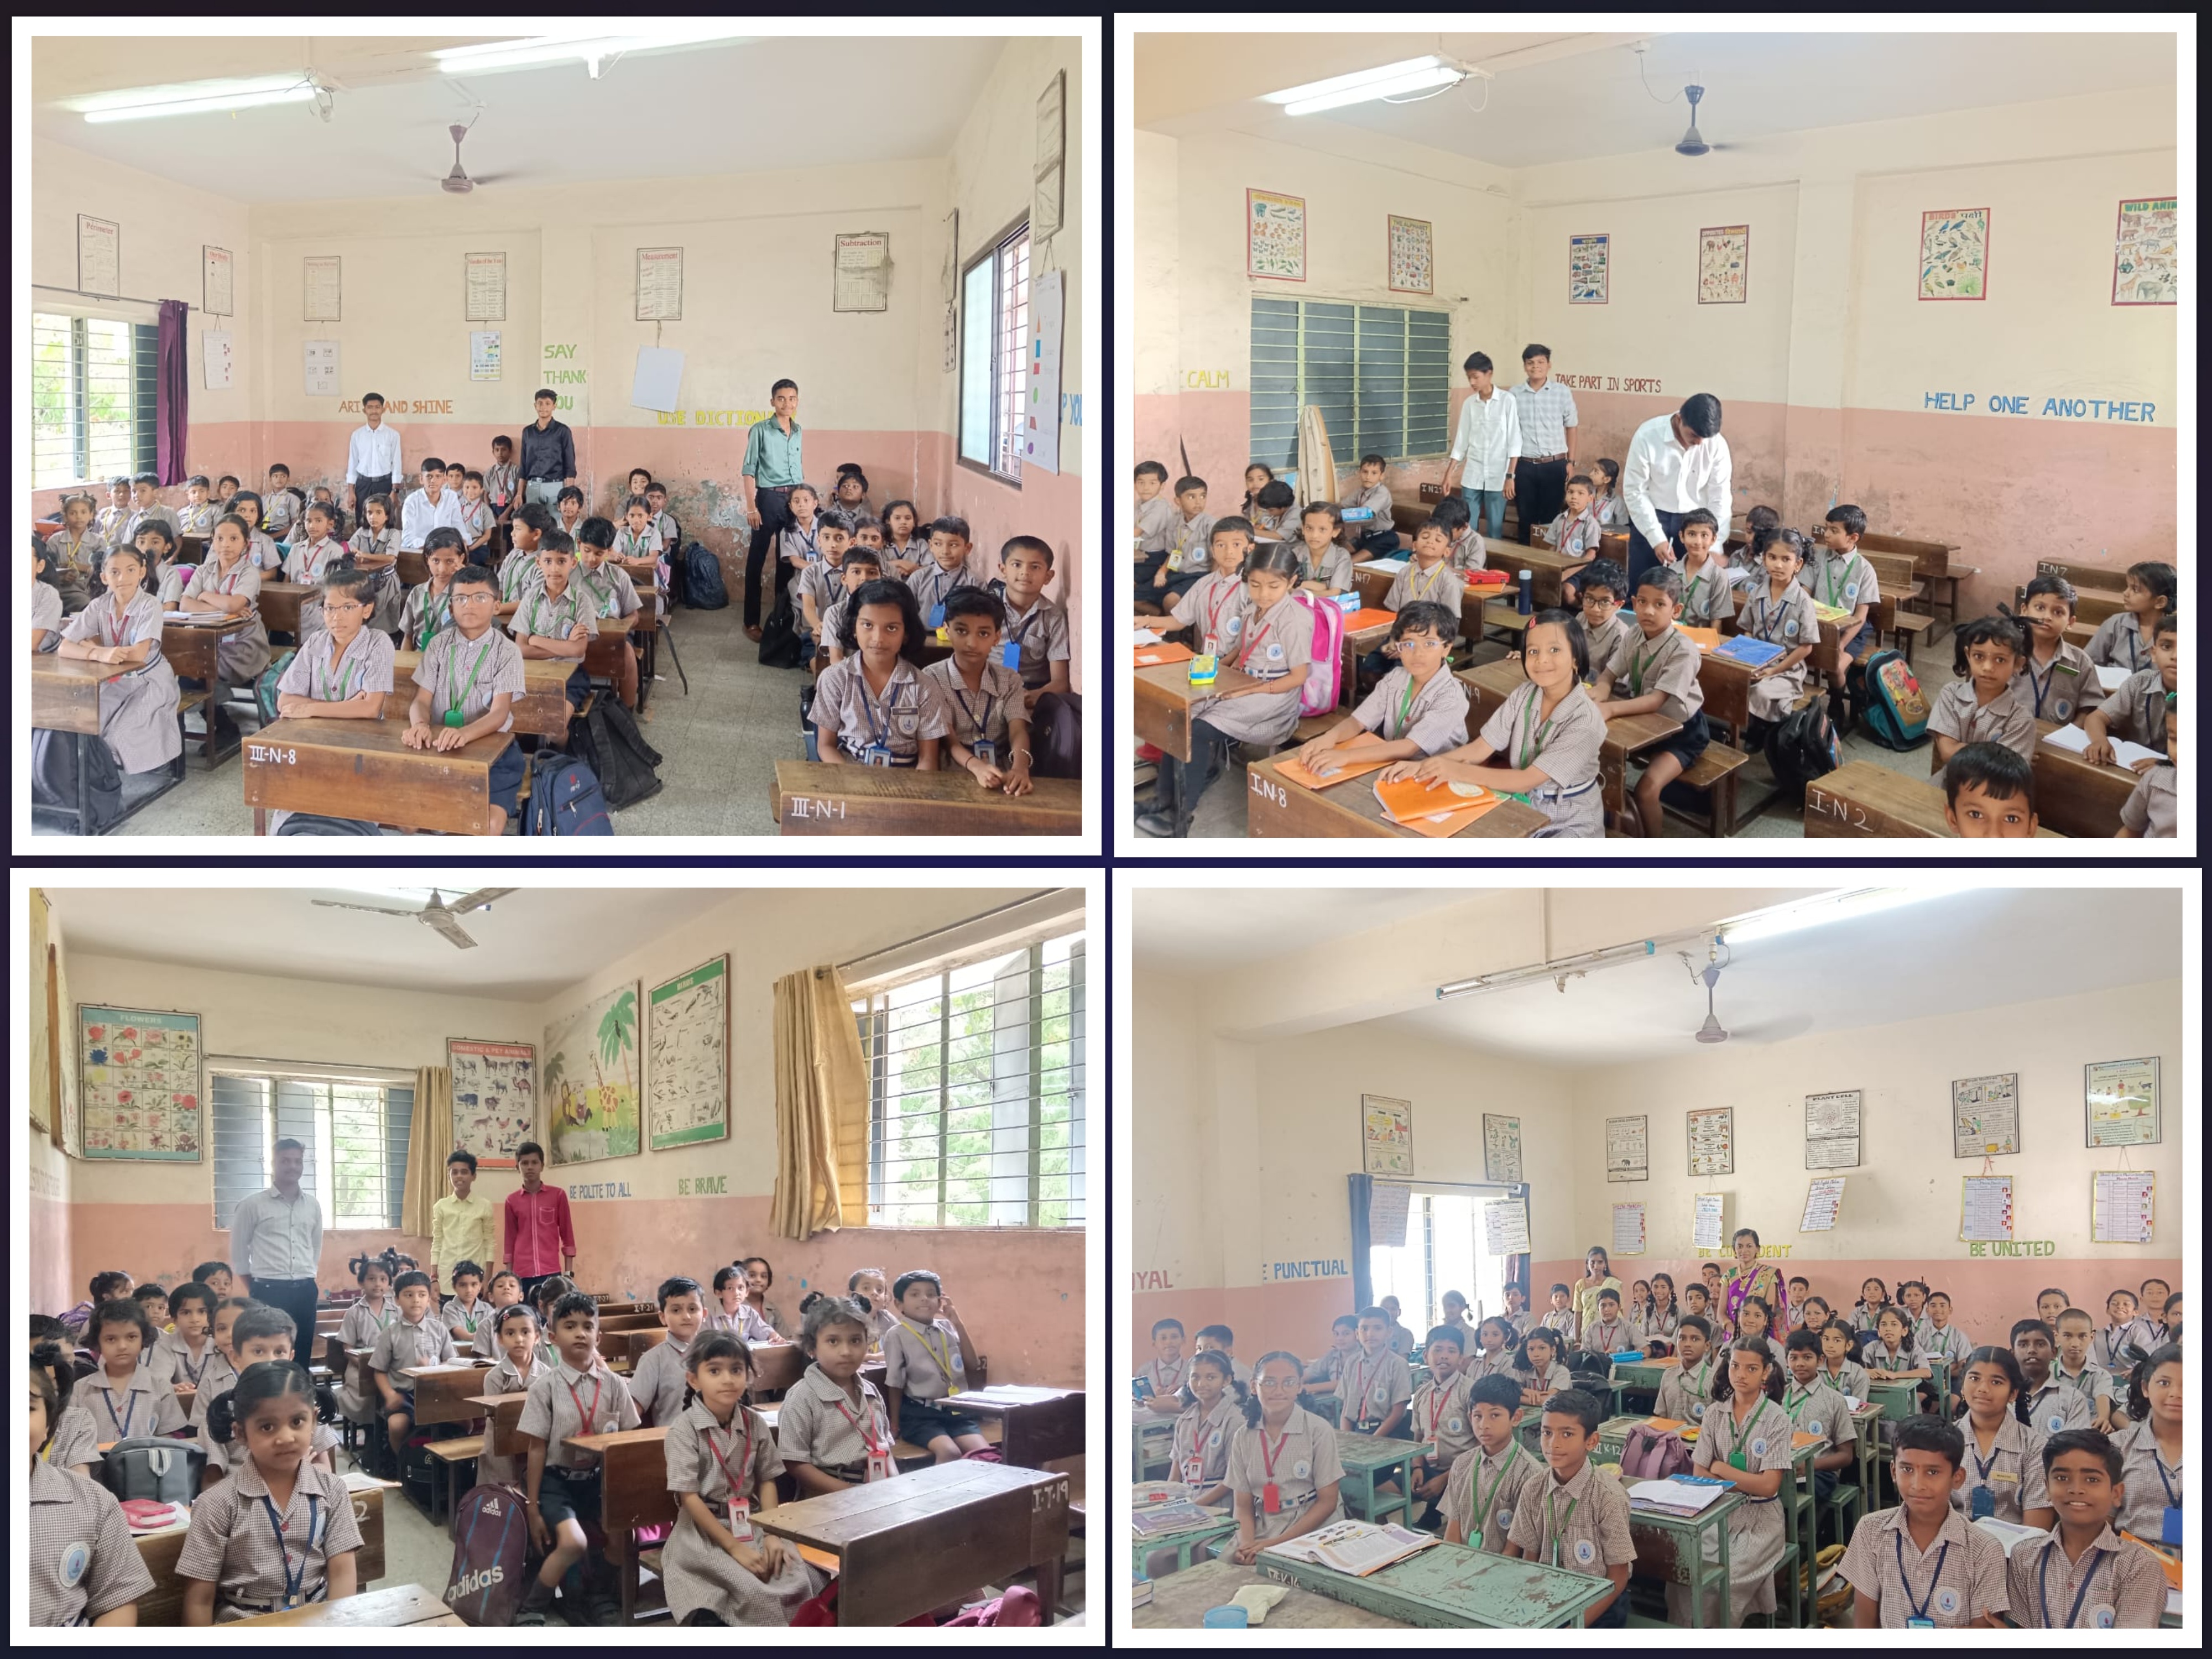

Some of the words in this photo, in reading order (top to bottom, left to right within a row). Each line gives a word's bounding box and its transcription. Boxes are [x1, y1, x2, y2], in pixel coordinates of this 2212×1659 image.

[2125, 202, 2149, 212] WILD
[86, 221, 114, 235] Perimeter
[840, 238, 881, 247] Subtraction
[642, 252, 678, 261] Measurement
[544, 345, 577, 359] SAY
[543, 370, 586, 384] THANK
[1187, 369, 1229, 389] CALM
[1555, 373, 1577, 388] TAKE
[1579, 375, 1602, 390] PART
[1606, 377, 1620, 391] IN
[1624, 377, 1662, 393] SPORTS
[383, 400, 408, 414] AND
[412, 400, 453, 414] SHINE
[1924, 392, 1975, 410] HELP
[1989, 395, 2030, 414] ONE
[2042, 398, 2156, 422] ANOTHER
[658, 411, 686, 425] USE
[248, 745, 296, 765] III-N-8
[120, 1014, 161, 1024] FLOWERS
[452, 1044, 484, 1053] DOMESTIC
[570, 1185, 577, 1199] BE
[579, 1183, 603, 1199] POLITE
[605, 1182, 616, 1198] TO
[618, 1182, 632, 1197] ALL
[679, 1178, 690, 1195] BE
[695, 1176, 727, 1194] BRAVE
[1970, 1242, 1986, 1257] BE
[1992, 1240, 2056, 1257] UNITED
[1274, 1260, 1348, 1280] PUNCTUAL
[482, 1506, 502, 1517] adidas
[447, 1566, 504, 1603] adidas
